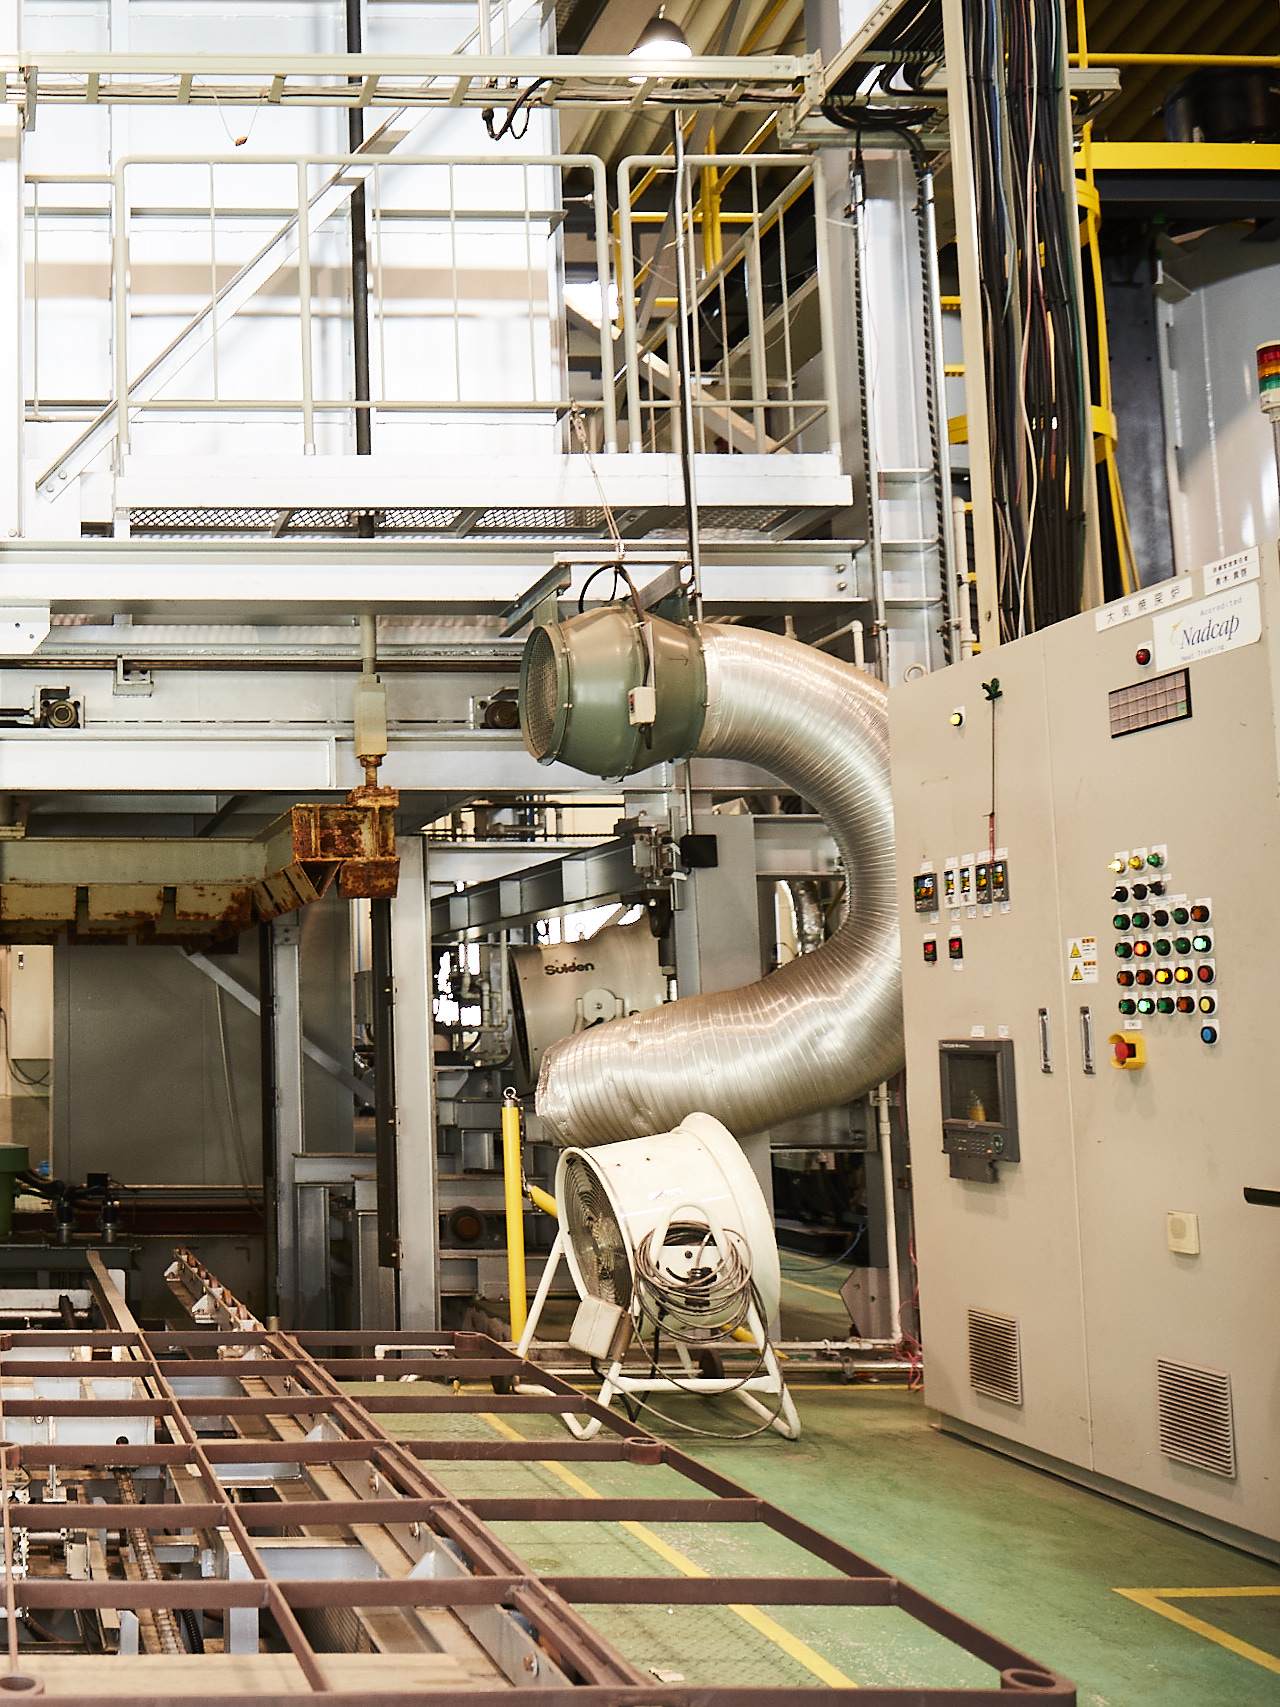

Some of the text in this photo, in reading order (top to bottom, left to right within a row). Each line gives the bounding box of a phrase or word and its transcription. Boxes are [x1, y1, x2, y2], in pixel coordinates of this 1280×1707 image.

[1200, 597, 1242, 616] Accredited
[1180, 614, 1240, 650] Nadcap
[1198, 644, 1225, 657] Treating
[544, 962, 595, 976] Suiden
